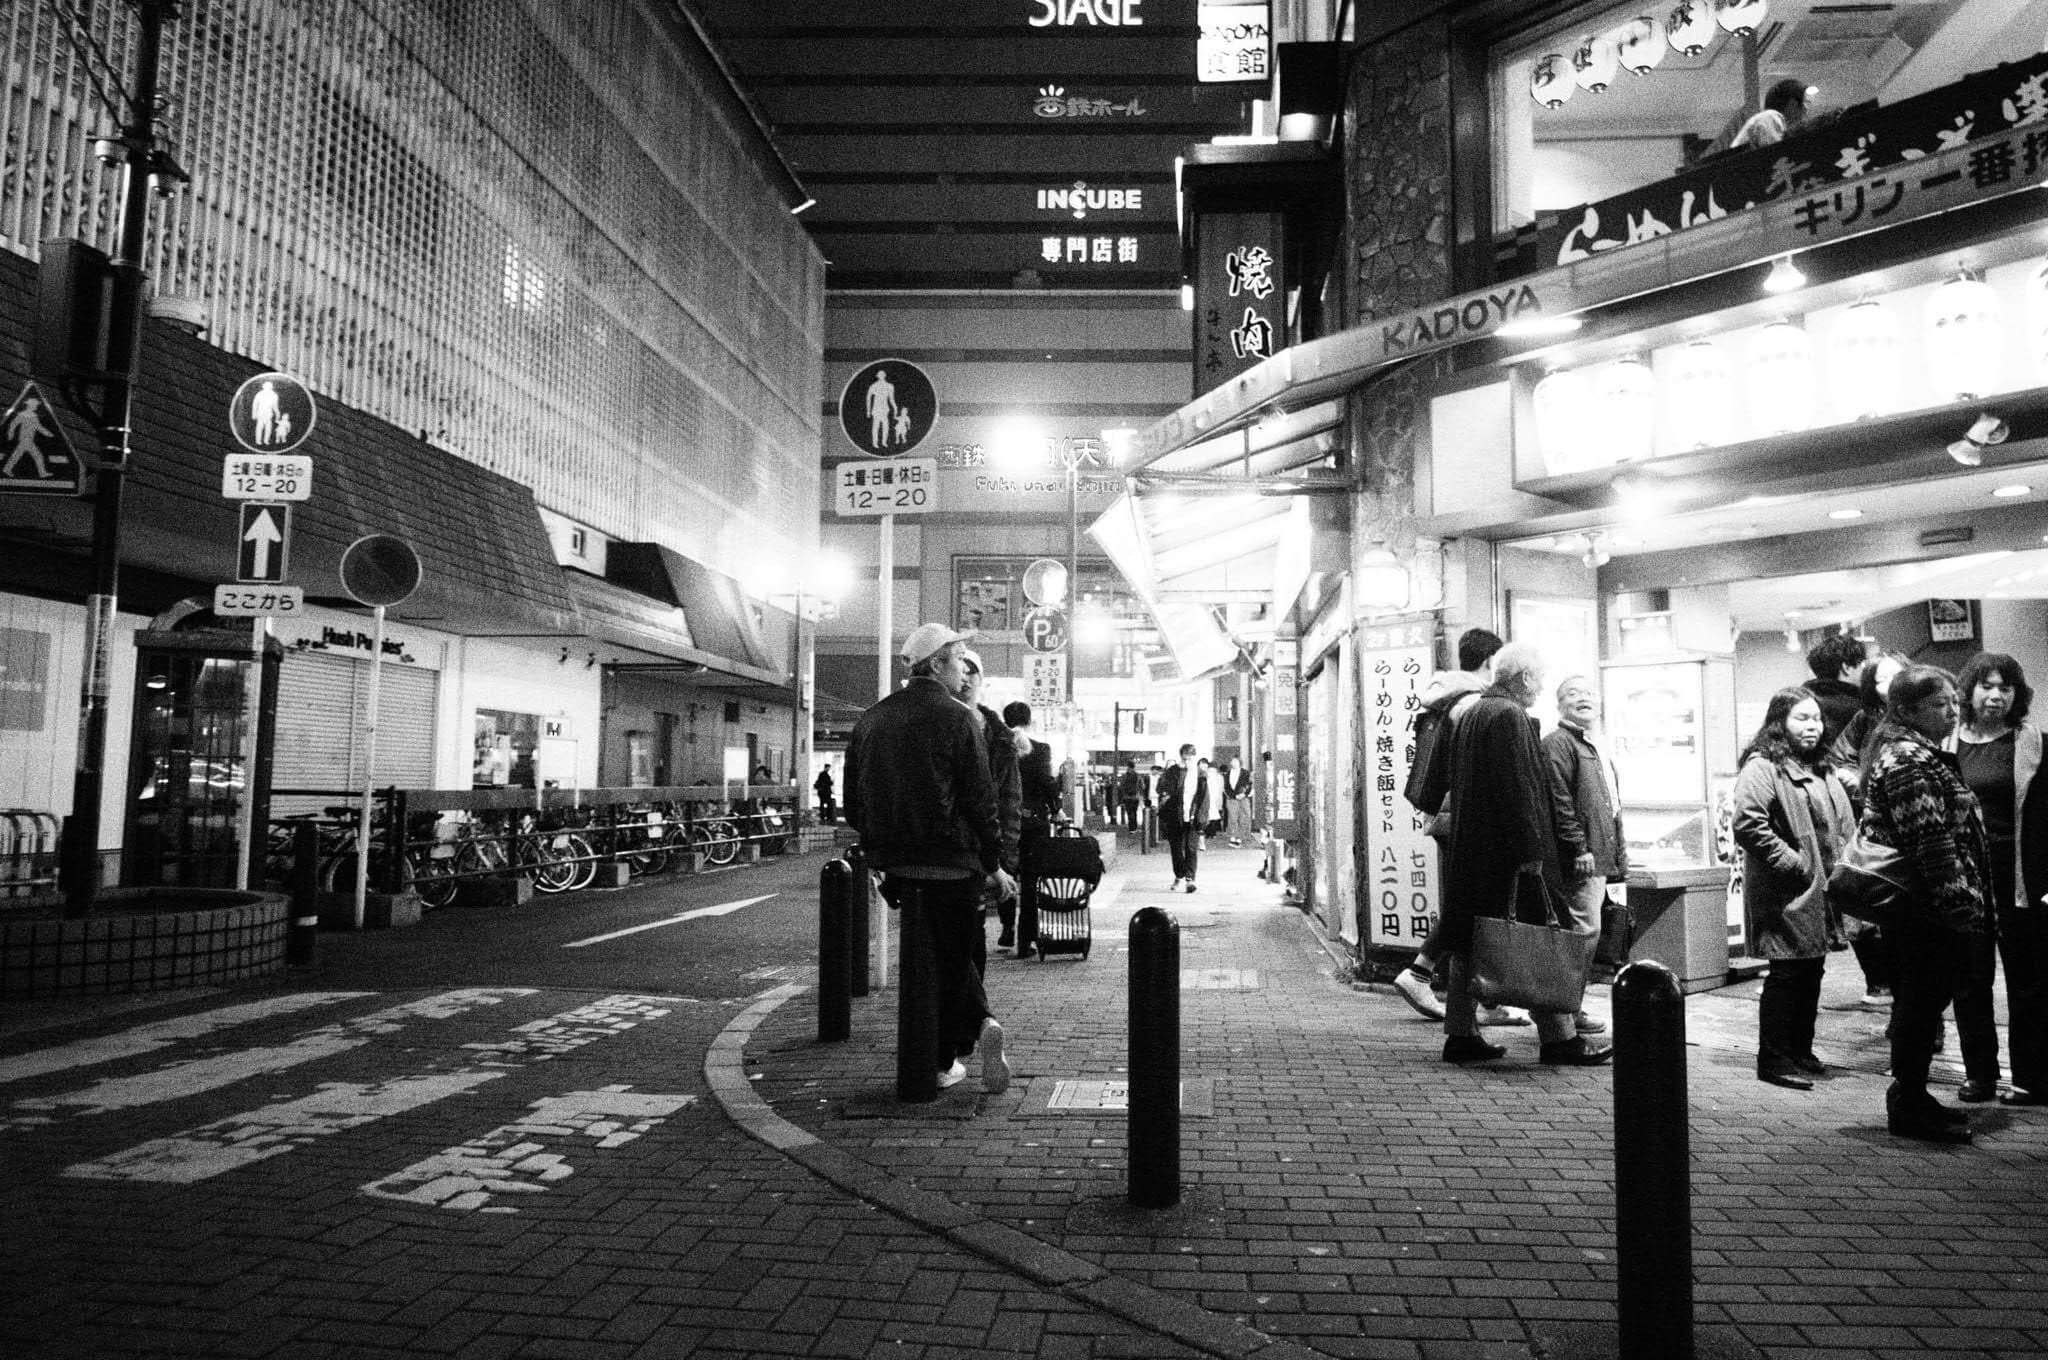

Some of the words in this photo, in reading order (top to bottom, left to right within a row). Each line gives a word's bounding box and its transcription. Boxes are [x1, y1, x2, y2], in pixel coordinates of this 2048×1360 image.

[1200, 23, 1269, 43] OYA
[1037, 187, 1142, 212] INCUBE
[1382, 284, 1542, 355] KADOYA
[222, 593, 294, 611] ここから
[322, 626, 355, 648] Hush
[356, 632, 405, 655] Puies
[1033, 618, 1052, 649] P
